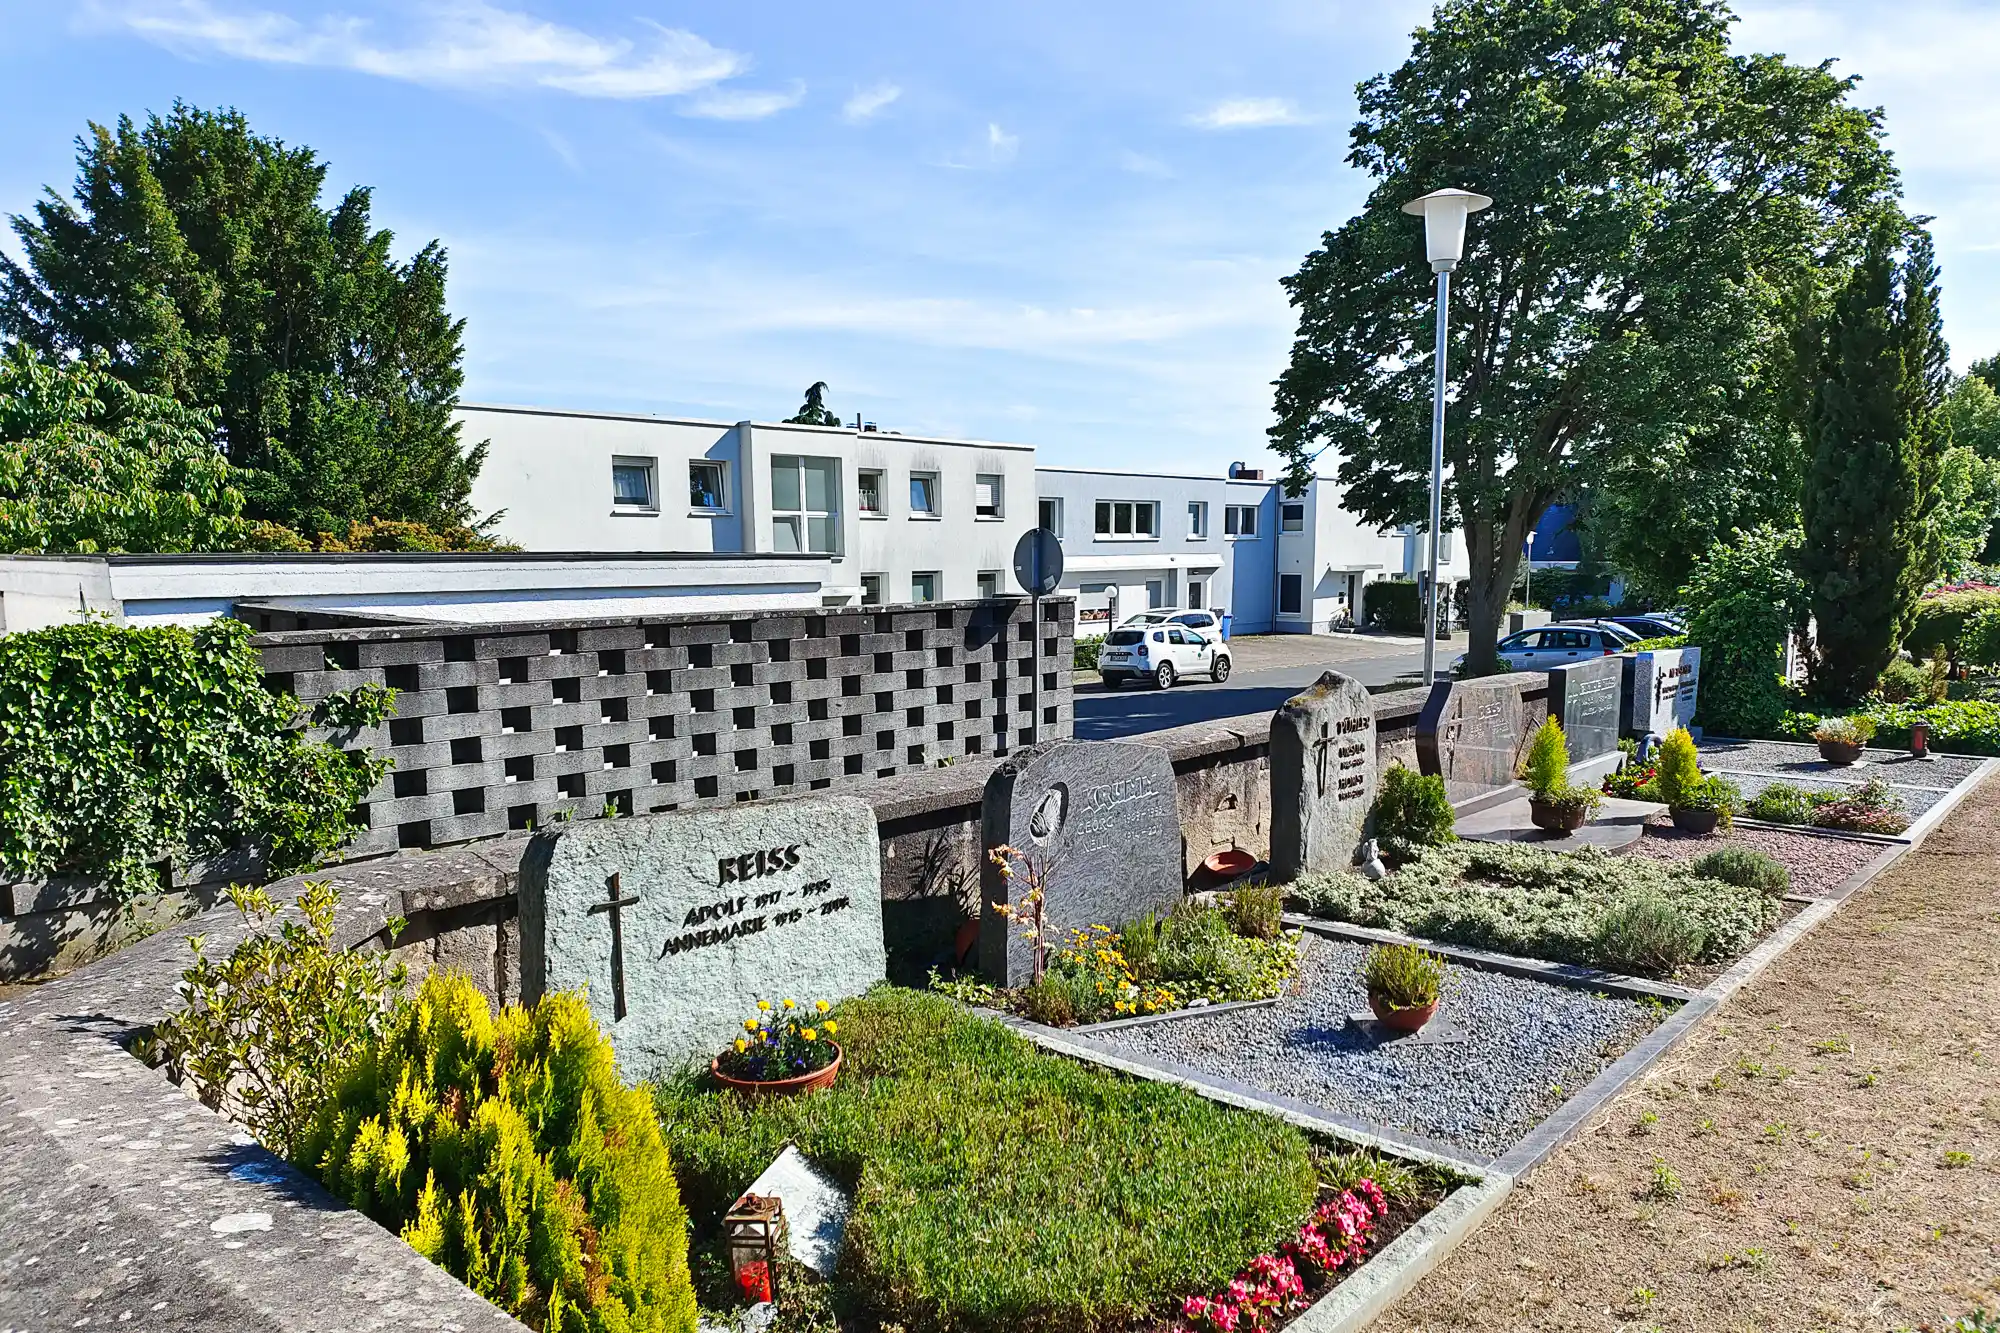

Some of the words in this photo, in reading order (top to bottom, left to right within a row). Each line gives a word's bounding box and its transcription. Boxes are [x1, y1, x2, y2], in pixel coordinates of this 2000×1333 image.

[717, 844, 801, 888] REISS
[682, 896, 748, 930] ADOLF
[656, 915, 768, 962] ANNEMARIE
